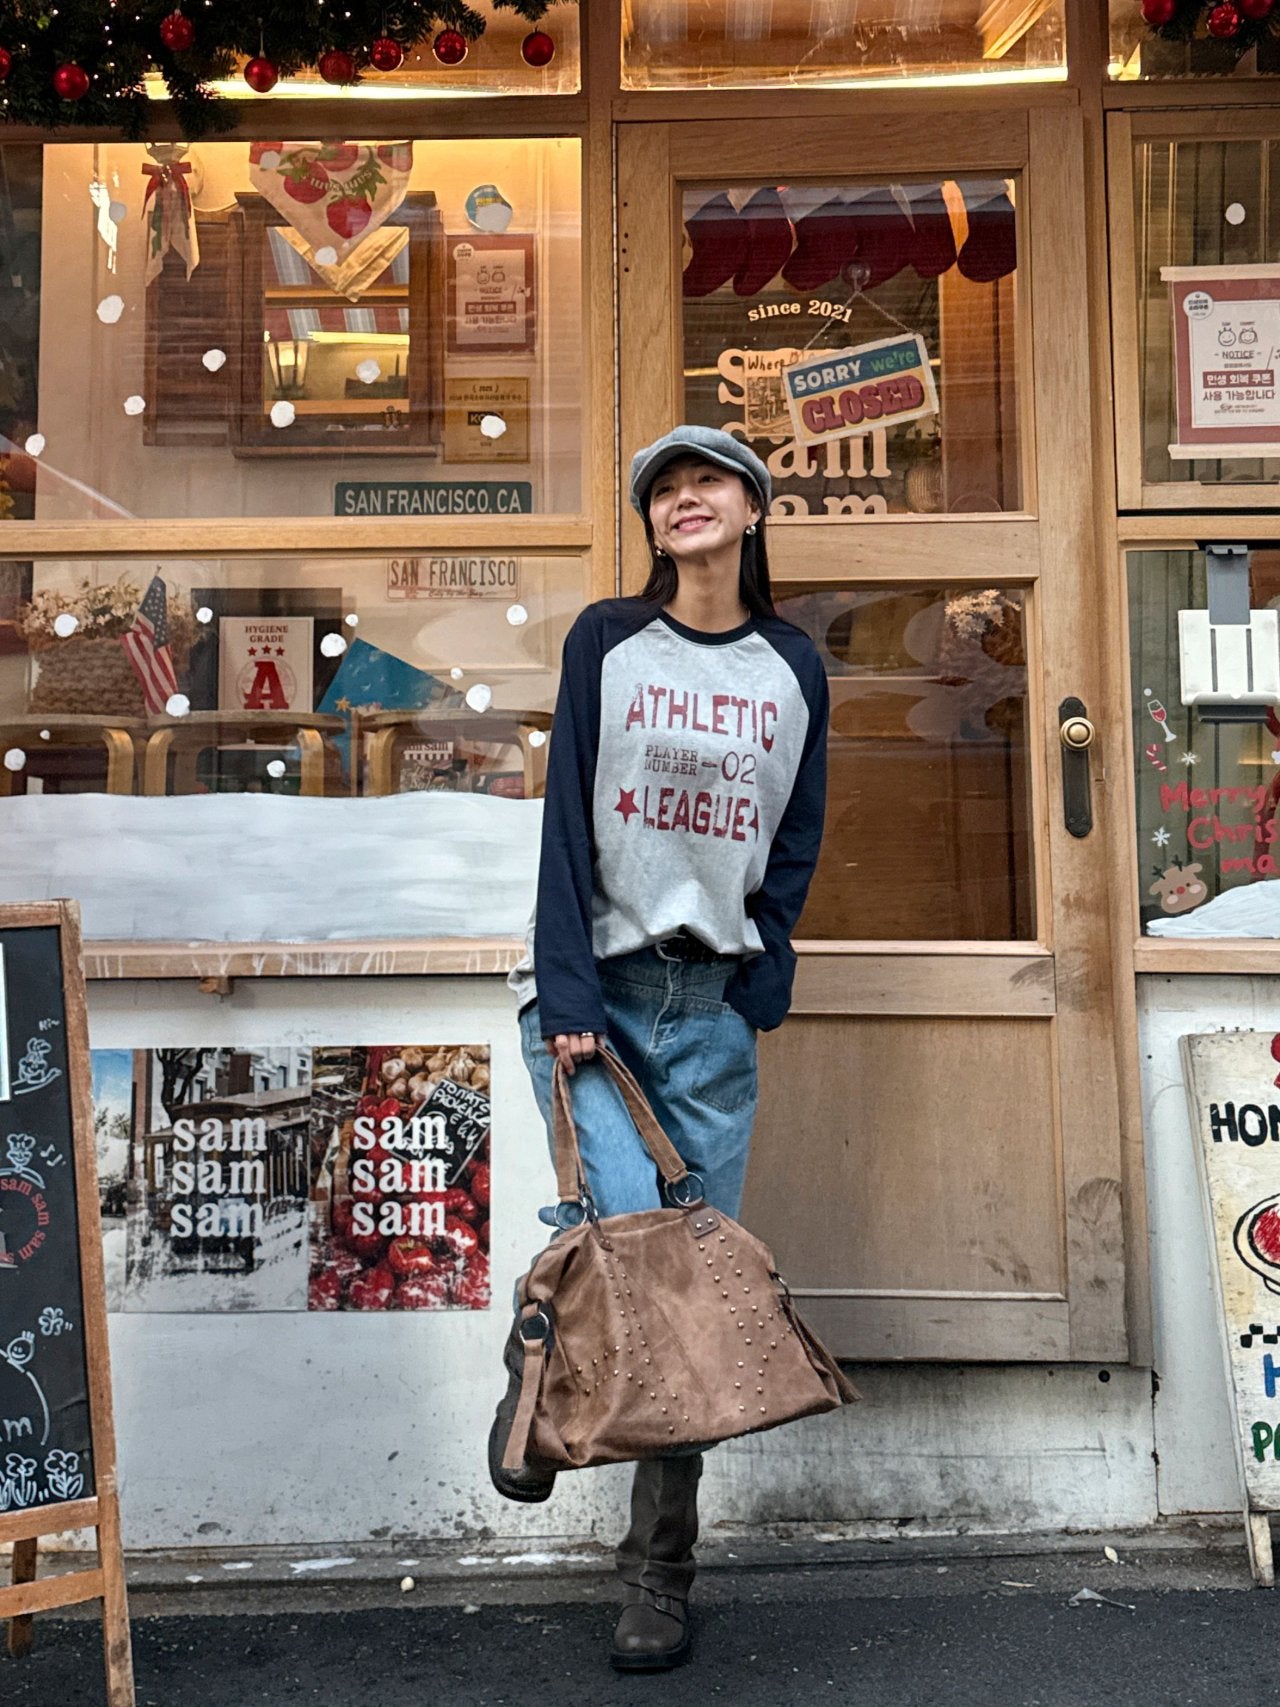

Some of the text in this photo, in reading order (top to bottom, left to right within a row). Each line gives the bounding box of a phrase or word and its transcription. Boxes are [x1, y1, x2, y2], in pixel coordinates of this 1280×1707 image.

[747, 300, 853, 323] since 2021
[794, 350, 915, 392] SORRY we're
[1222, 350, 1255, 360] NOTICE
[802, 375, 925, 434] CLOSED
[1203, 390, 1222, 401] 사용
[345, 489, 380, 513] SAN
[497, 489, 521, 513] CA
[391, 560, 516, 586] SAN FRANCISCO
[245, 625, 288, 633] HYGIENE
[249, 635, 284, 643] GRADE
[243, 661, 289, 709] A
[625, 683, 778, 753] ATHLETIC
[644, 758, 697, 776] NUMBER
[645, 745, 698, 762] PLAYER
[643, 785, 751, 842] LEAGUE
[1159, 780, 1265, 813] Merry
[173, 1118, 268, 1152] sam
[353, 1116, 448, 1150] sam
[172, 1159, 267, 1194] sam
[352, 1158, 448, 1193] sam
[0, 1179, 49, 1260] sam sam sam
[170, 1203, 264, 1238] sam
[352, 1201, 447, 1236] sam
